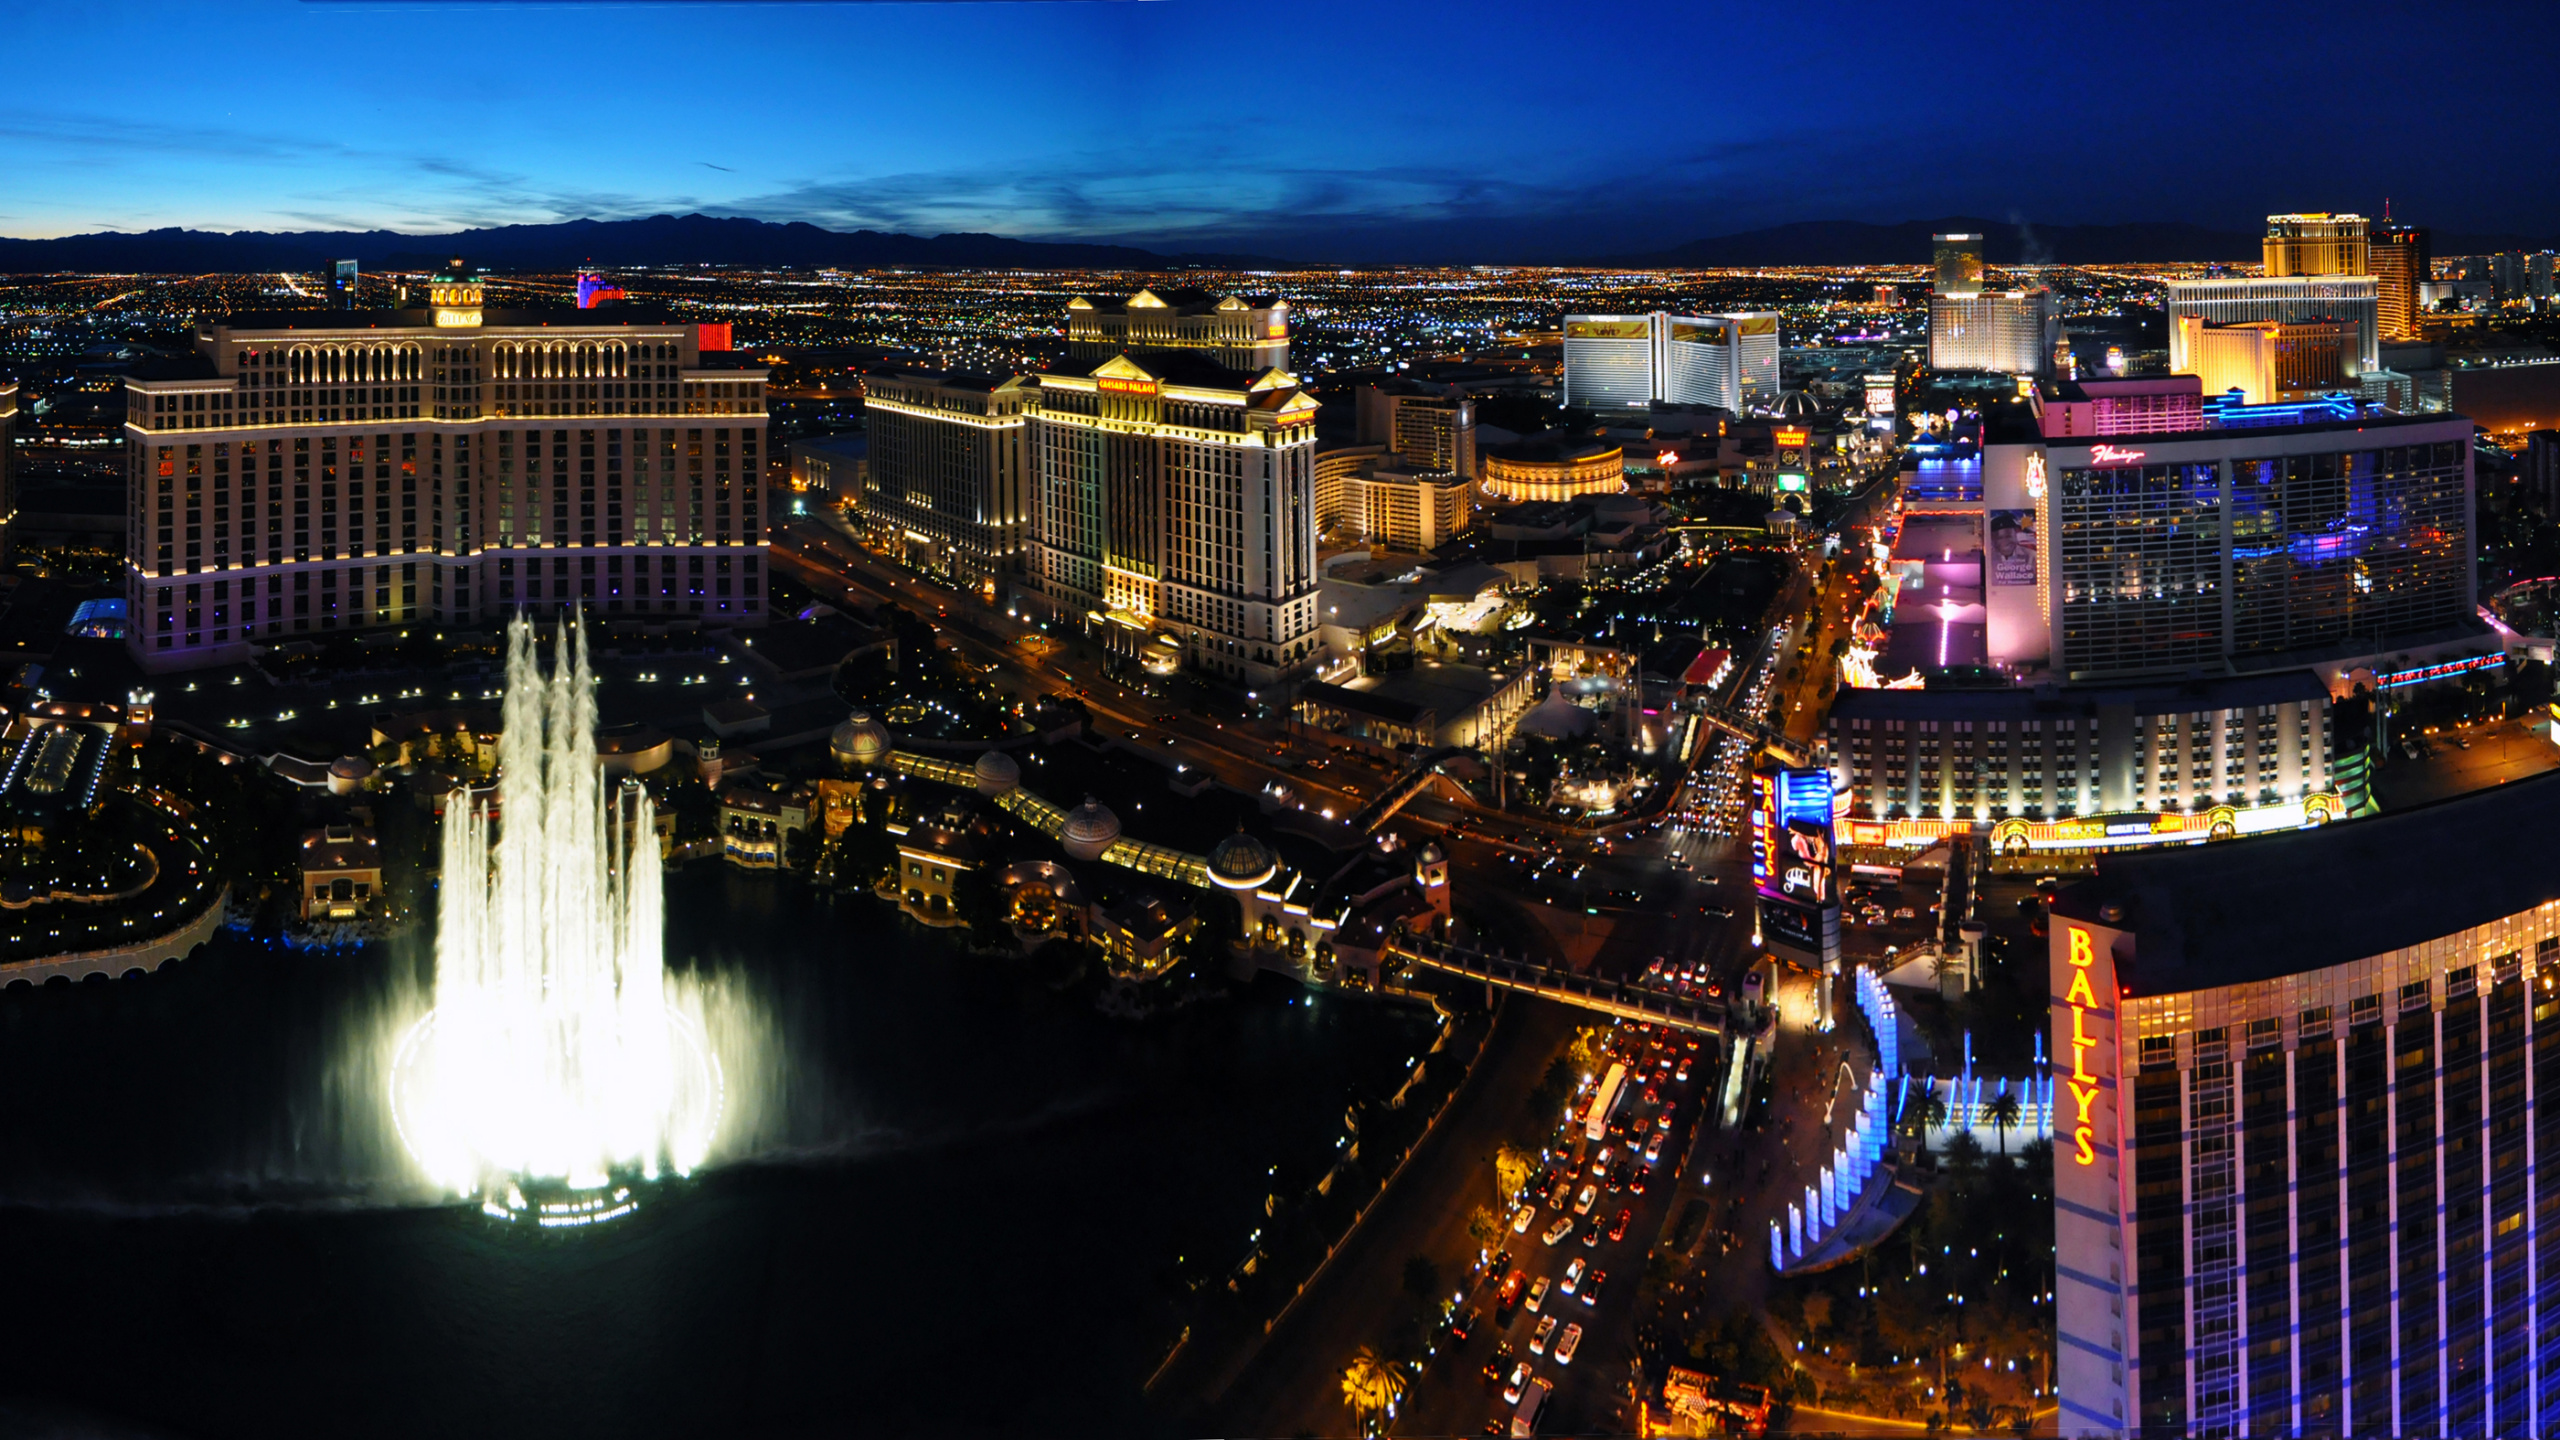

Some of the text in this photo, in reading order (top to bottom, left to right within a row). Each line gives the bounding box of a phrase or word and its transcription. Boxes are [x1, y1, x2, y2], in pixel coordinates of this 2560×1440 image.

[1098, 379, 1156, 394] CAESARS PALACE
[2090, 444, 2145, 464] Flamingo
[1995, 572, 2034, 580] Wallace
[1997, 563, 2032, 572] George
[1762, 778, 1776, 877] BALLYS
[2065, 926, 2099, 1166] BALLYS
